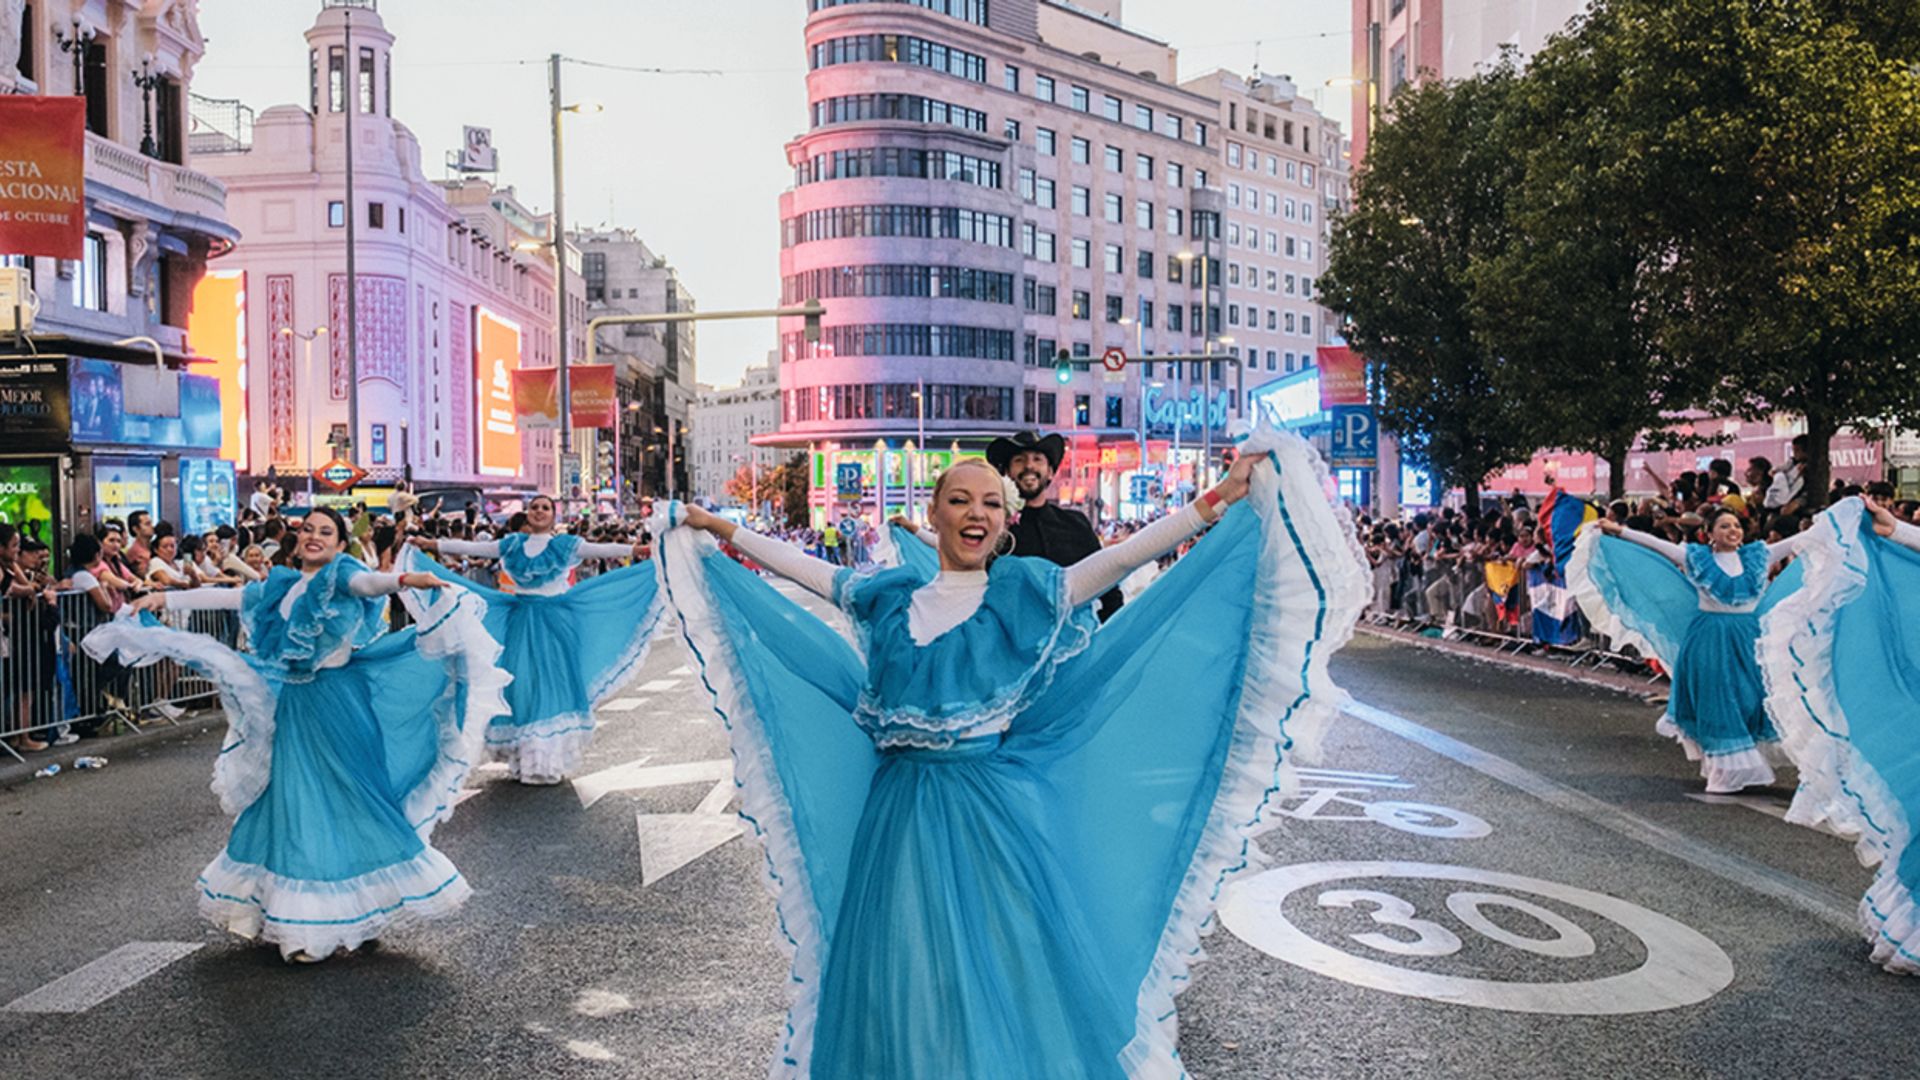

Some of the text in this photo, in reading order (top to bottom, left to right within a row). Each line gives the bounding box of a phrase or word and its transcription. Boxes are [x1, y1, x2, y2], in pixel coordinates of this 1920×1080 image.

[14, 210, 70, 225] OCTUBRE
[432, 301, 441, 458] CALLAO
[1145, 387, 1227, 428] Capitol
[1344, 413, 1370, 449] P
[0, 482, 39, 494] SOLEIL
[843, 467, 858, 489] P
[1318, 889, 1596, 958] 30
